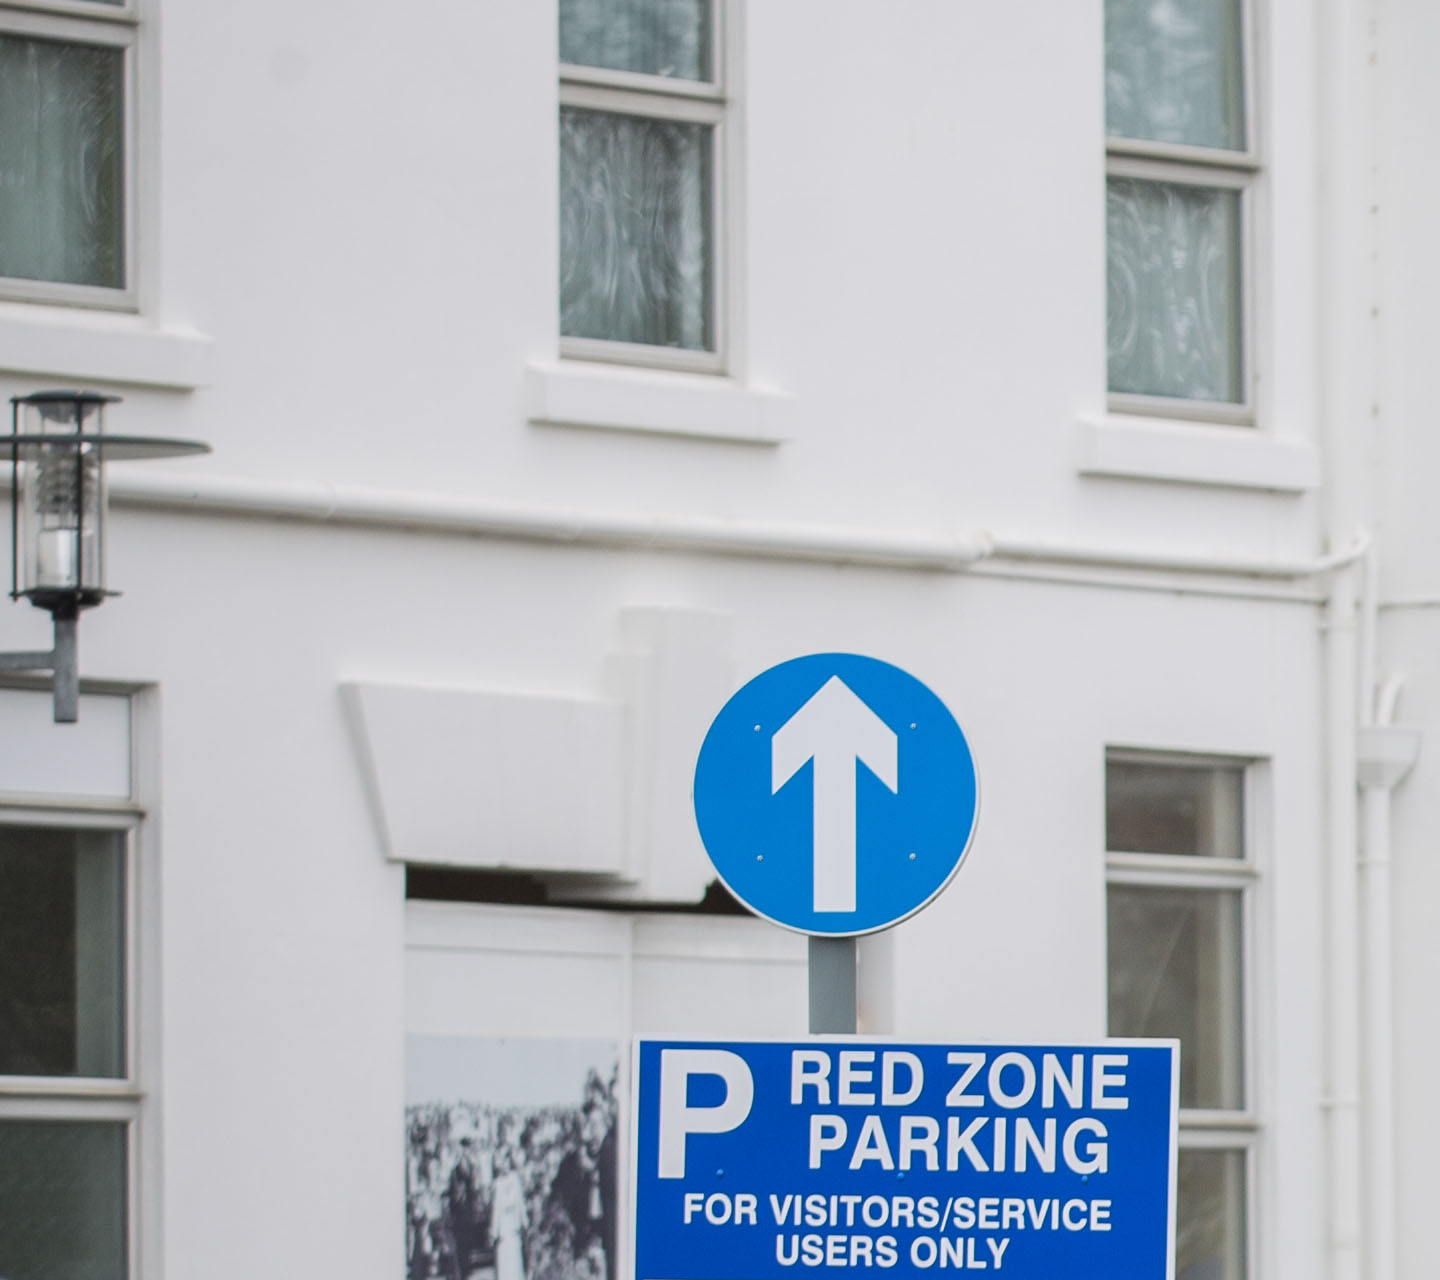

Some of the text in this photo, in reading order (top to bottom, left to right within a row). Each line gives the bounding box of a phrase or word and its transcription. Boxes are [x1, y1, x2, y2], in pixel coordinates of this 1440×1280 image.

[790, 1050, 1129, 1110] RED ZONE
[657, 1048, 754, 1179] P
[809, 1114, 1108, 1175] PARKING
[684, 1193, 1112, 1232] FOR VISITORS/SERVICE
[775, 1234, 1010, 1269] USERS ONLY
